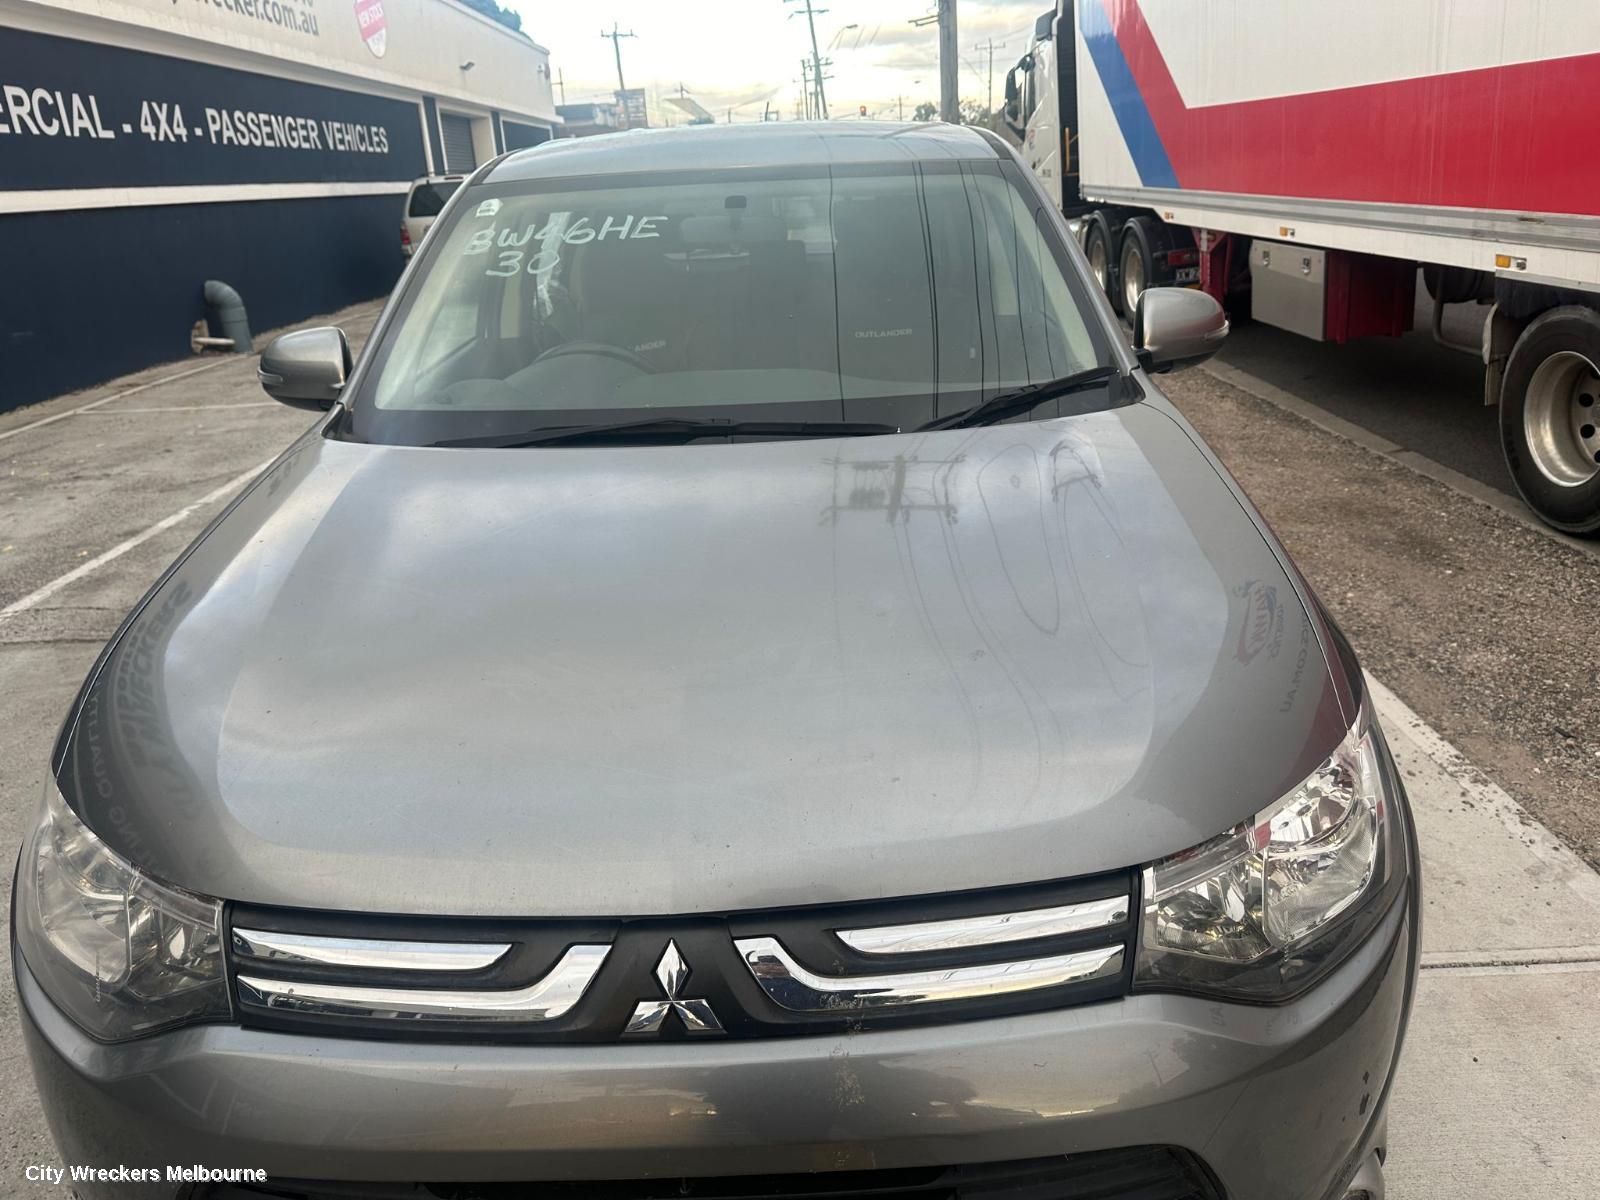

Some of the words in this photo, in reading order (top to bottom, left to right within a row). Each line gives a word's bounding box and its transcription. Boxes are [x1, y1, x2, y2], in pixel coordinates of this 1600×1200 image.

[171, 0, 319, 36] cker.com.au
[140, 100, 188, 142] 4X4
[205, 107, 322, 149] PASSENGER
[321, 120, 389, 153] VEHICLES
[854, 327, 913, 339] OUTLANDER
